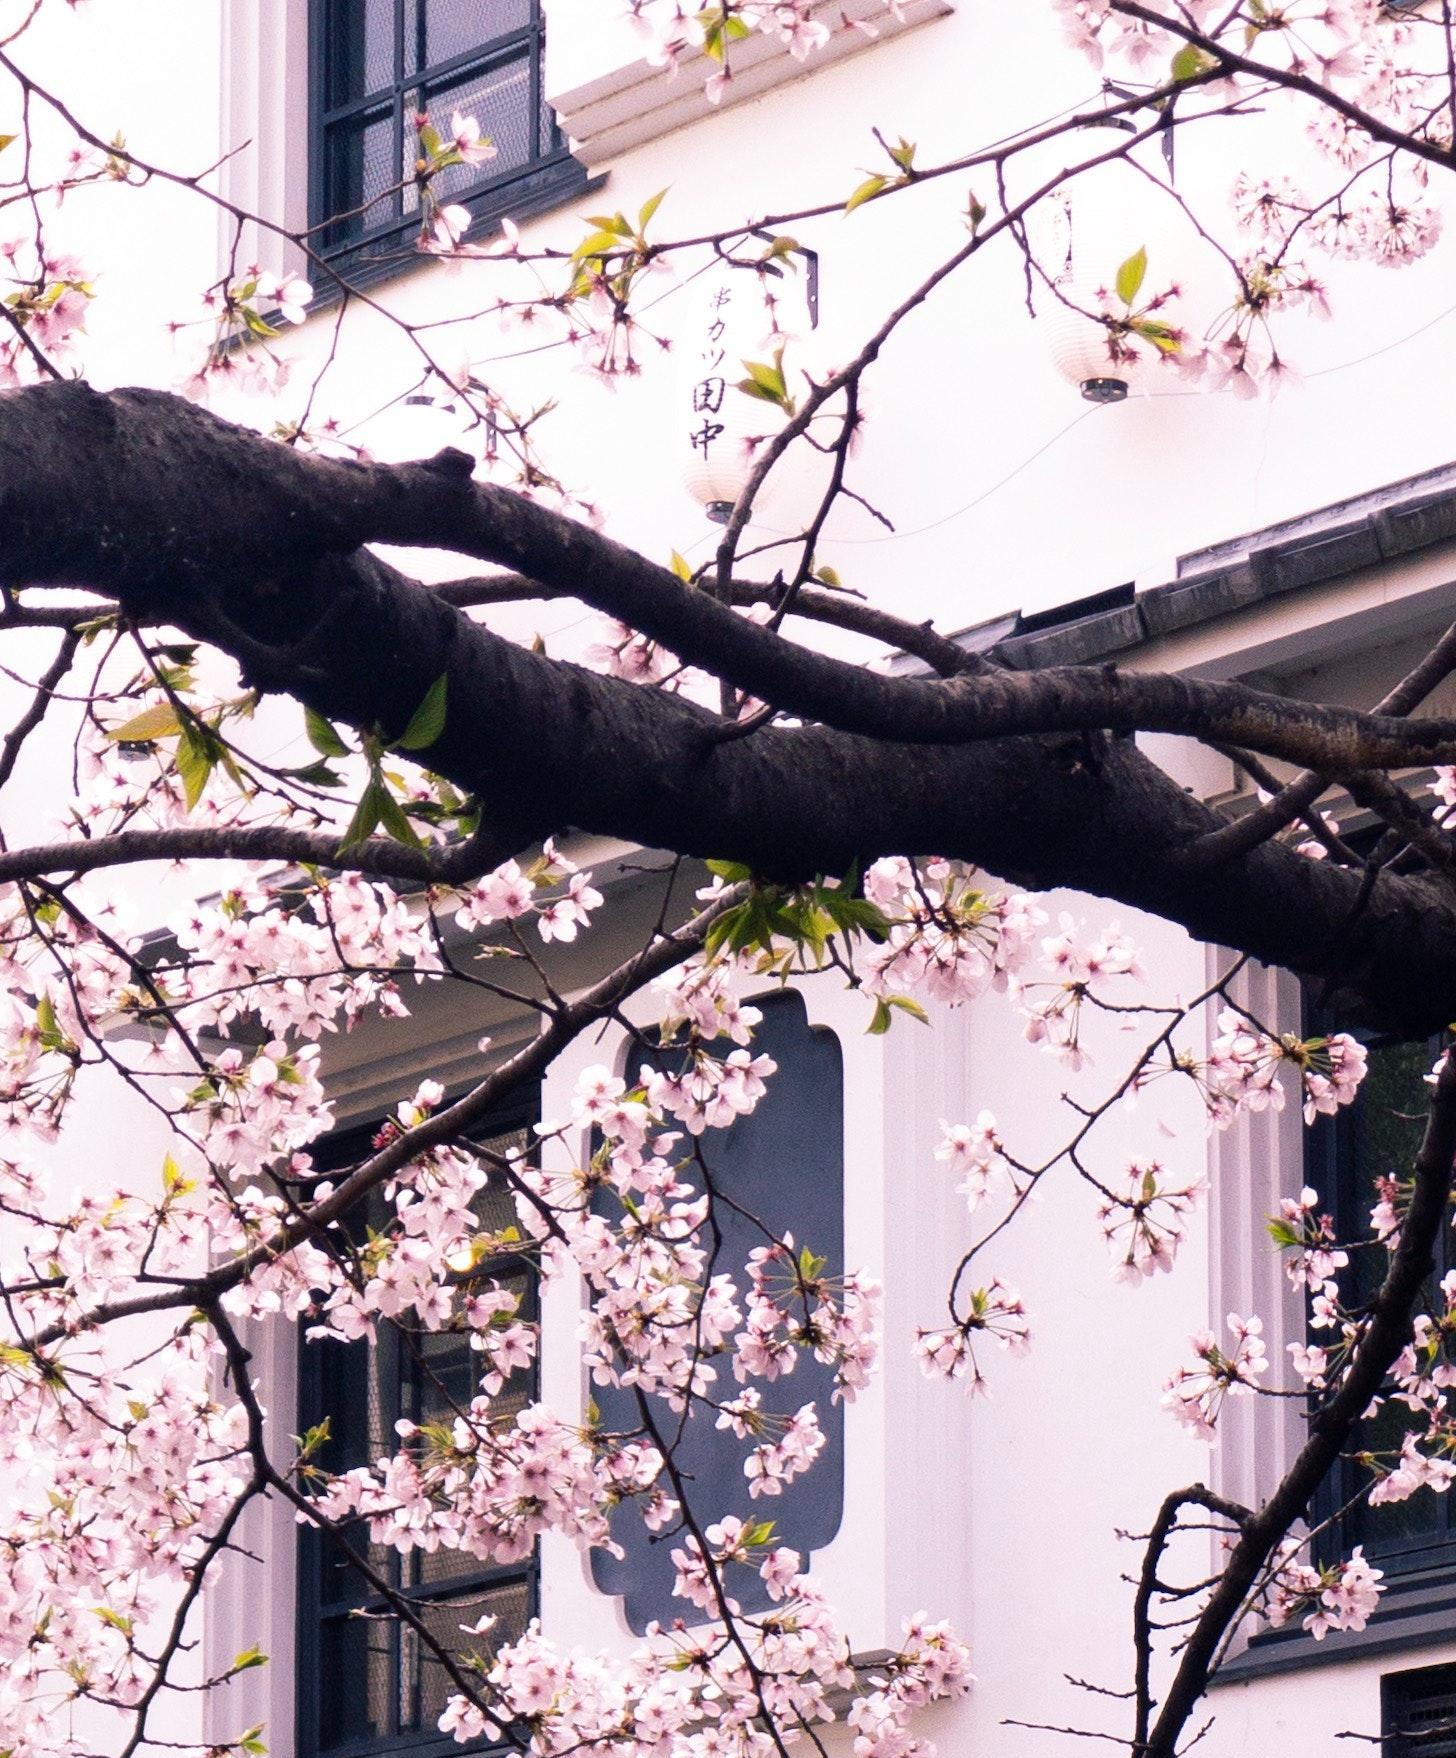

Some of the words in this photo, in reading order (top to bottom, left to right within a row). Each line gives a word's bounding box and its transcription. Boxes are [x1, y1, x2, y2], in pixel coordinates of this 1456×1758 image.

[689, 285, 732, 462] 串カツ田中
